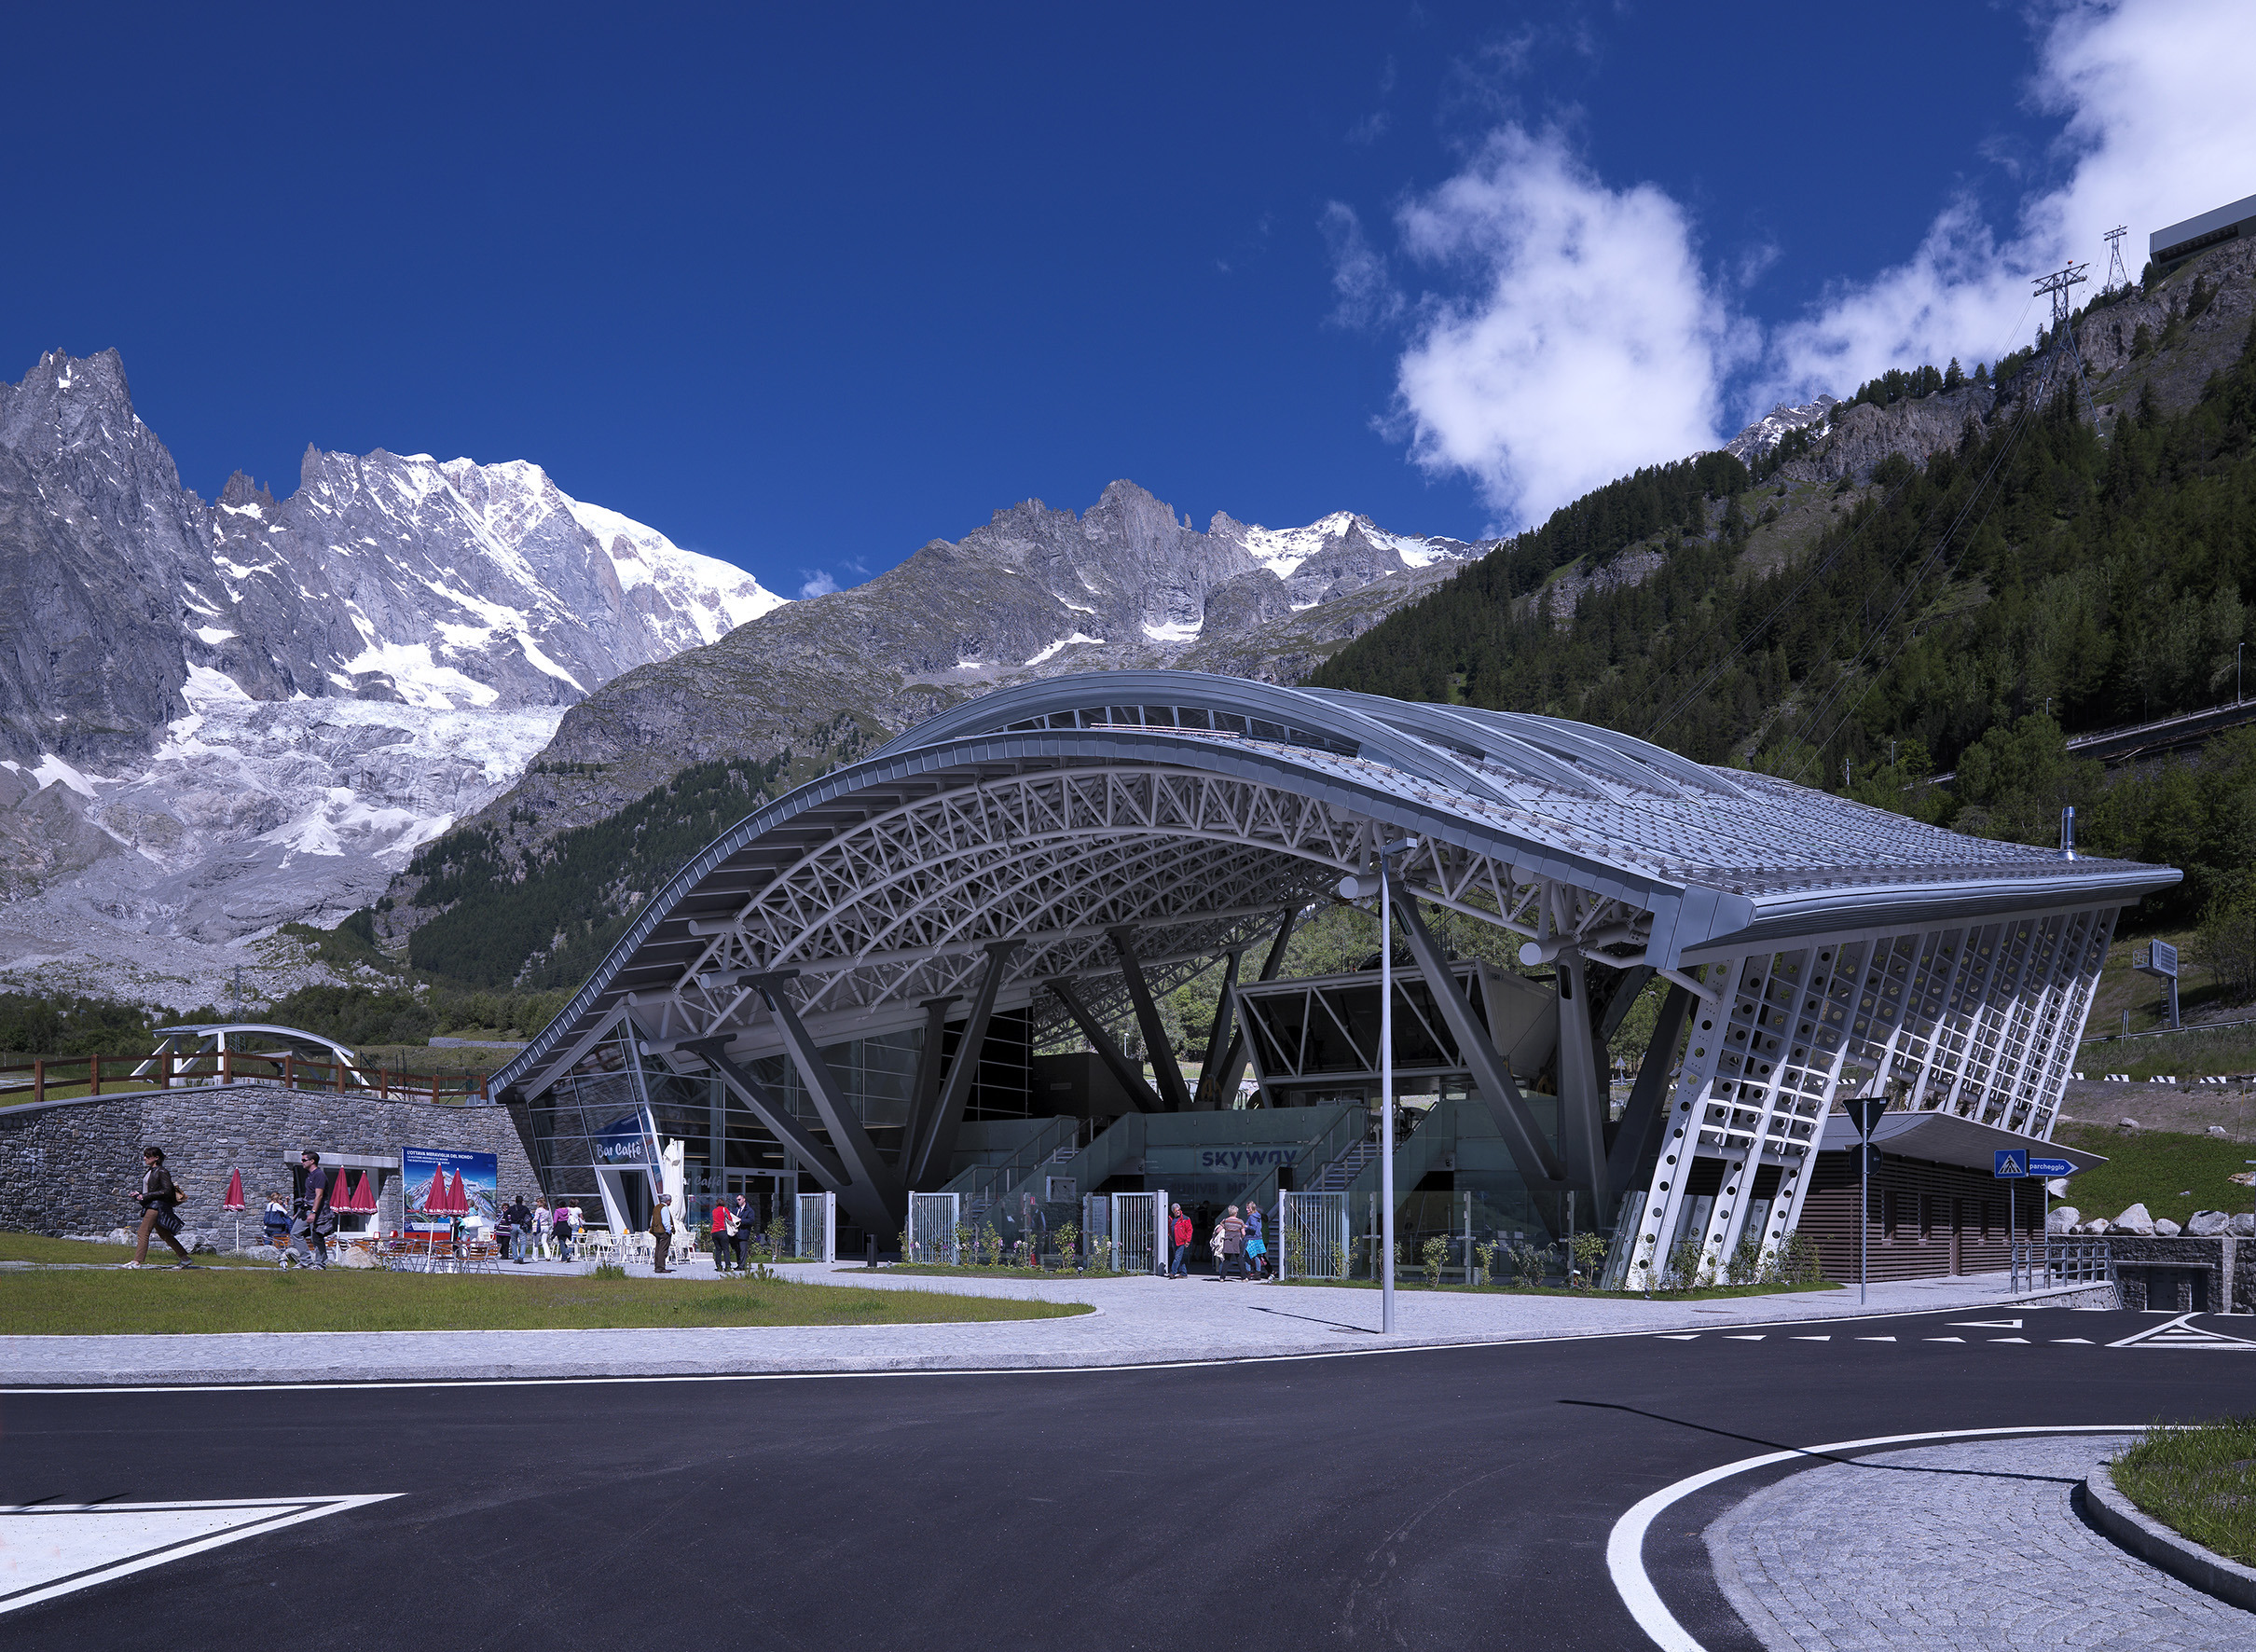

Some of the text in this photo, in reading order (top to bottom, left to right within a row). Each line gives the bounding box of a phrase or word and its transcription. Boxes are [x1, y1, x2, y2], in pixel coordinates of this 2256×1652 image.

[596, 1141, 641, 1158] Bar Caffè
[695, 1176, 722, 1188] Caffè
